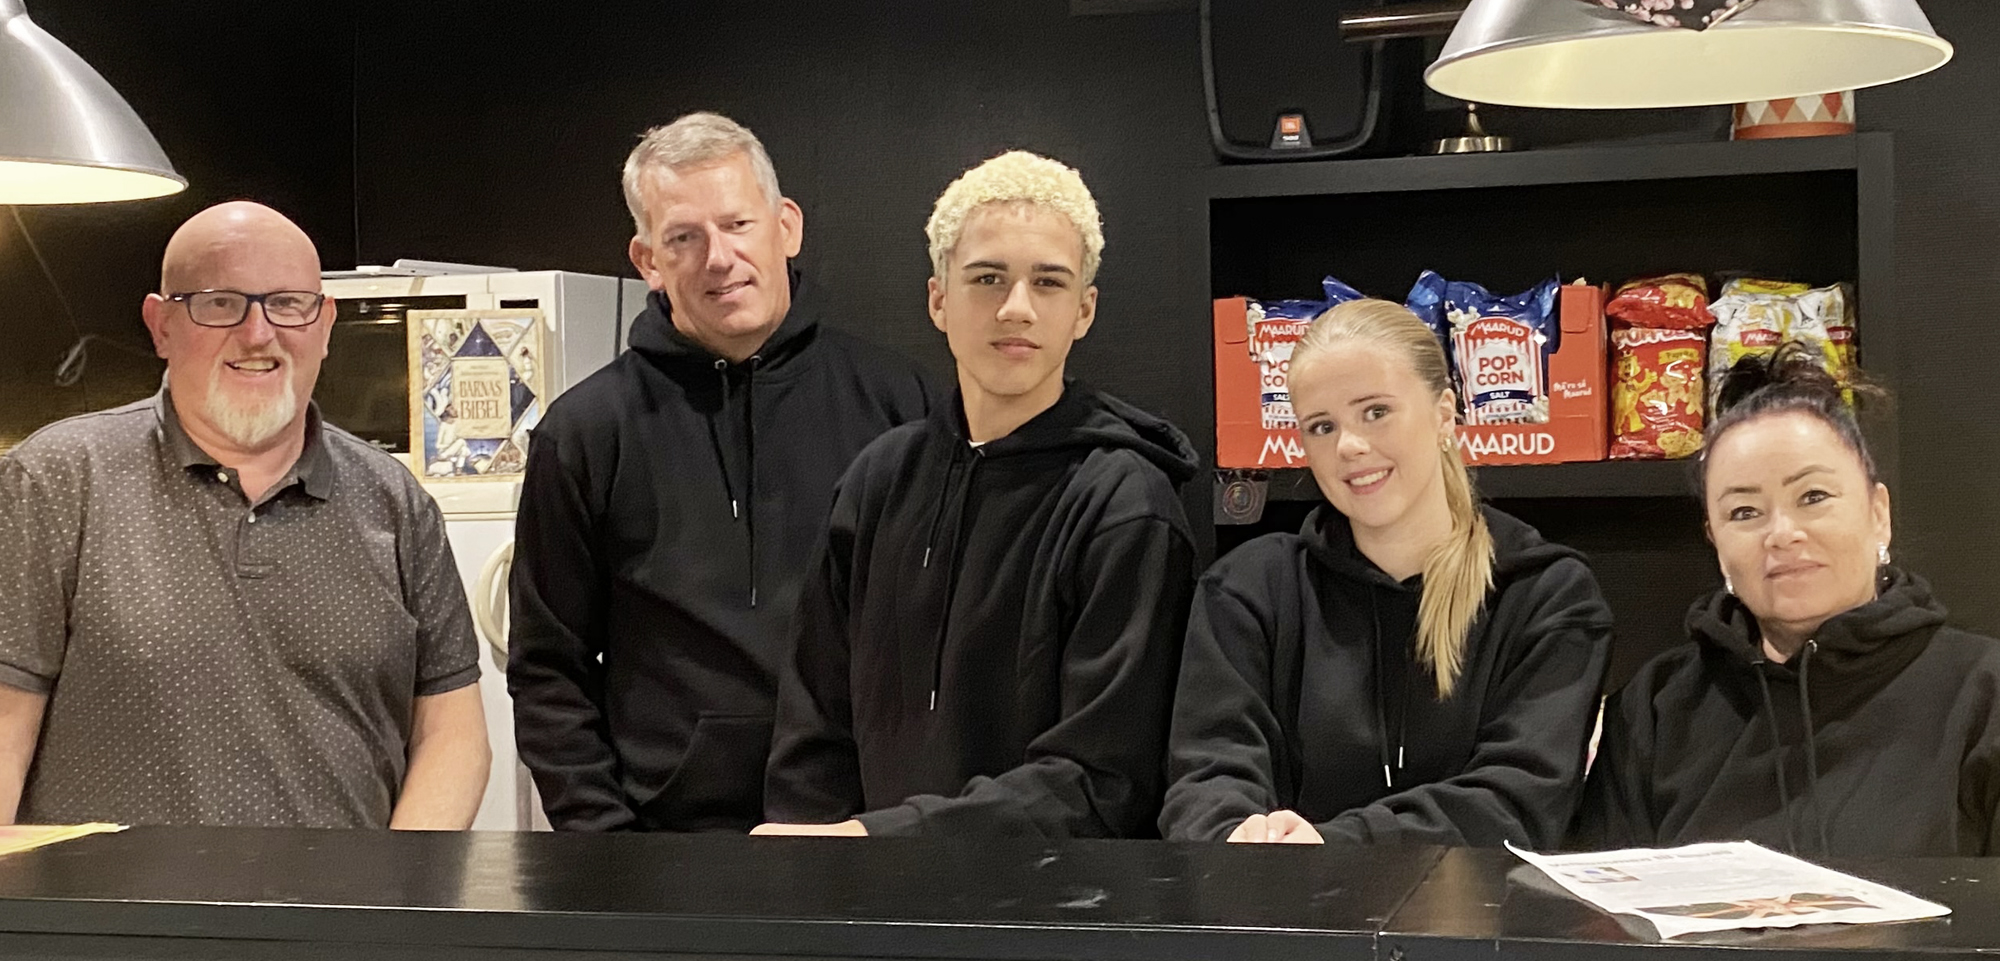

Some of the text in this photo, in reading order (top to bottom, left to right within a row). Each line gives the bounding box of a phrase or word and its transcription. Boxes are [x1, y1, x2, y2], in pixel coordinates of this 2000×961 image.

[1470, 322, 1526, 337] MAARUD
[1268, 360, 1289, 373] PO
[1479, 355, 1518, 372] POP
[1264, 375, 1284, 387] CO
[1476, 370, 1525, 386] CORN
[459, 380, 503, 398] BARNAS
[1489, 391, 1511, 399] SALT
[460, 399, 504, 420] BIBEL
[1456, 432, 1555, 461] MAARUD
